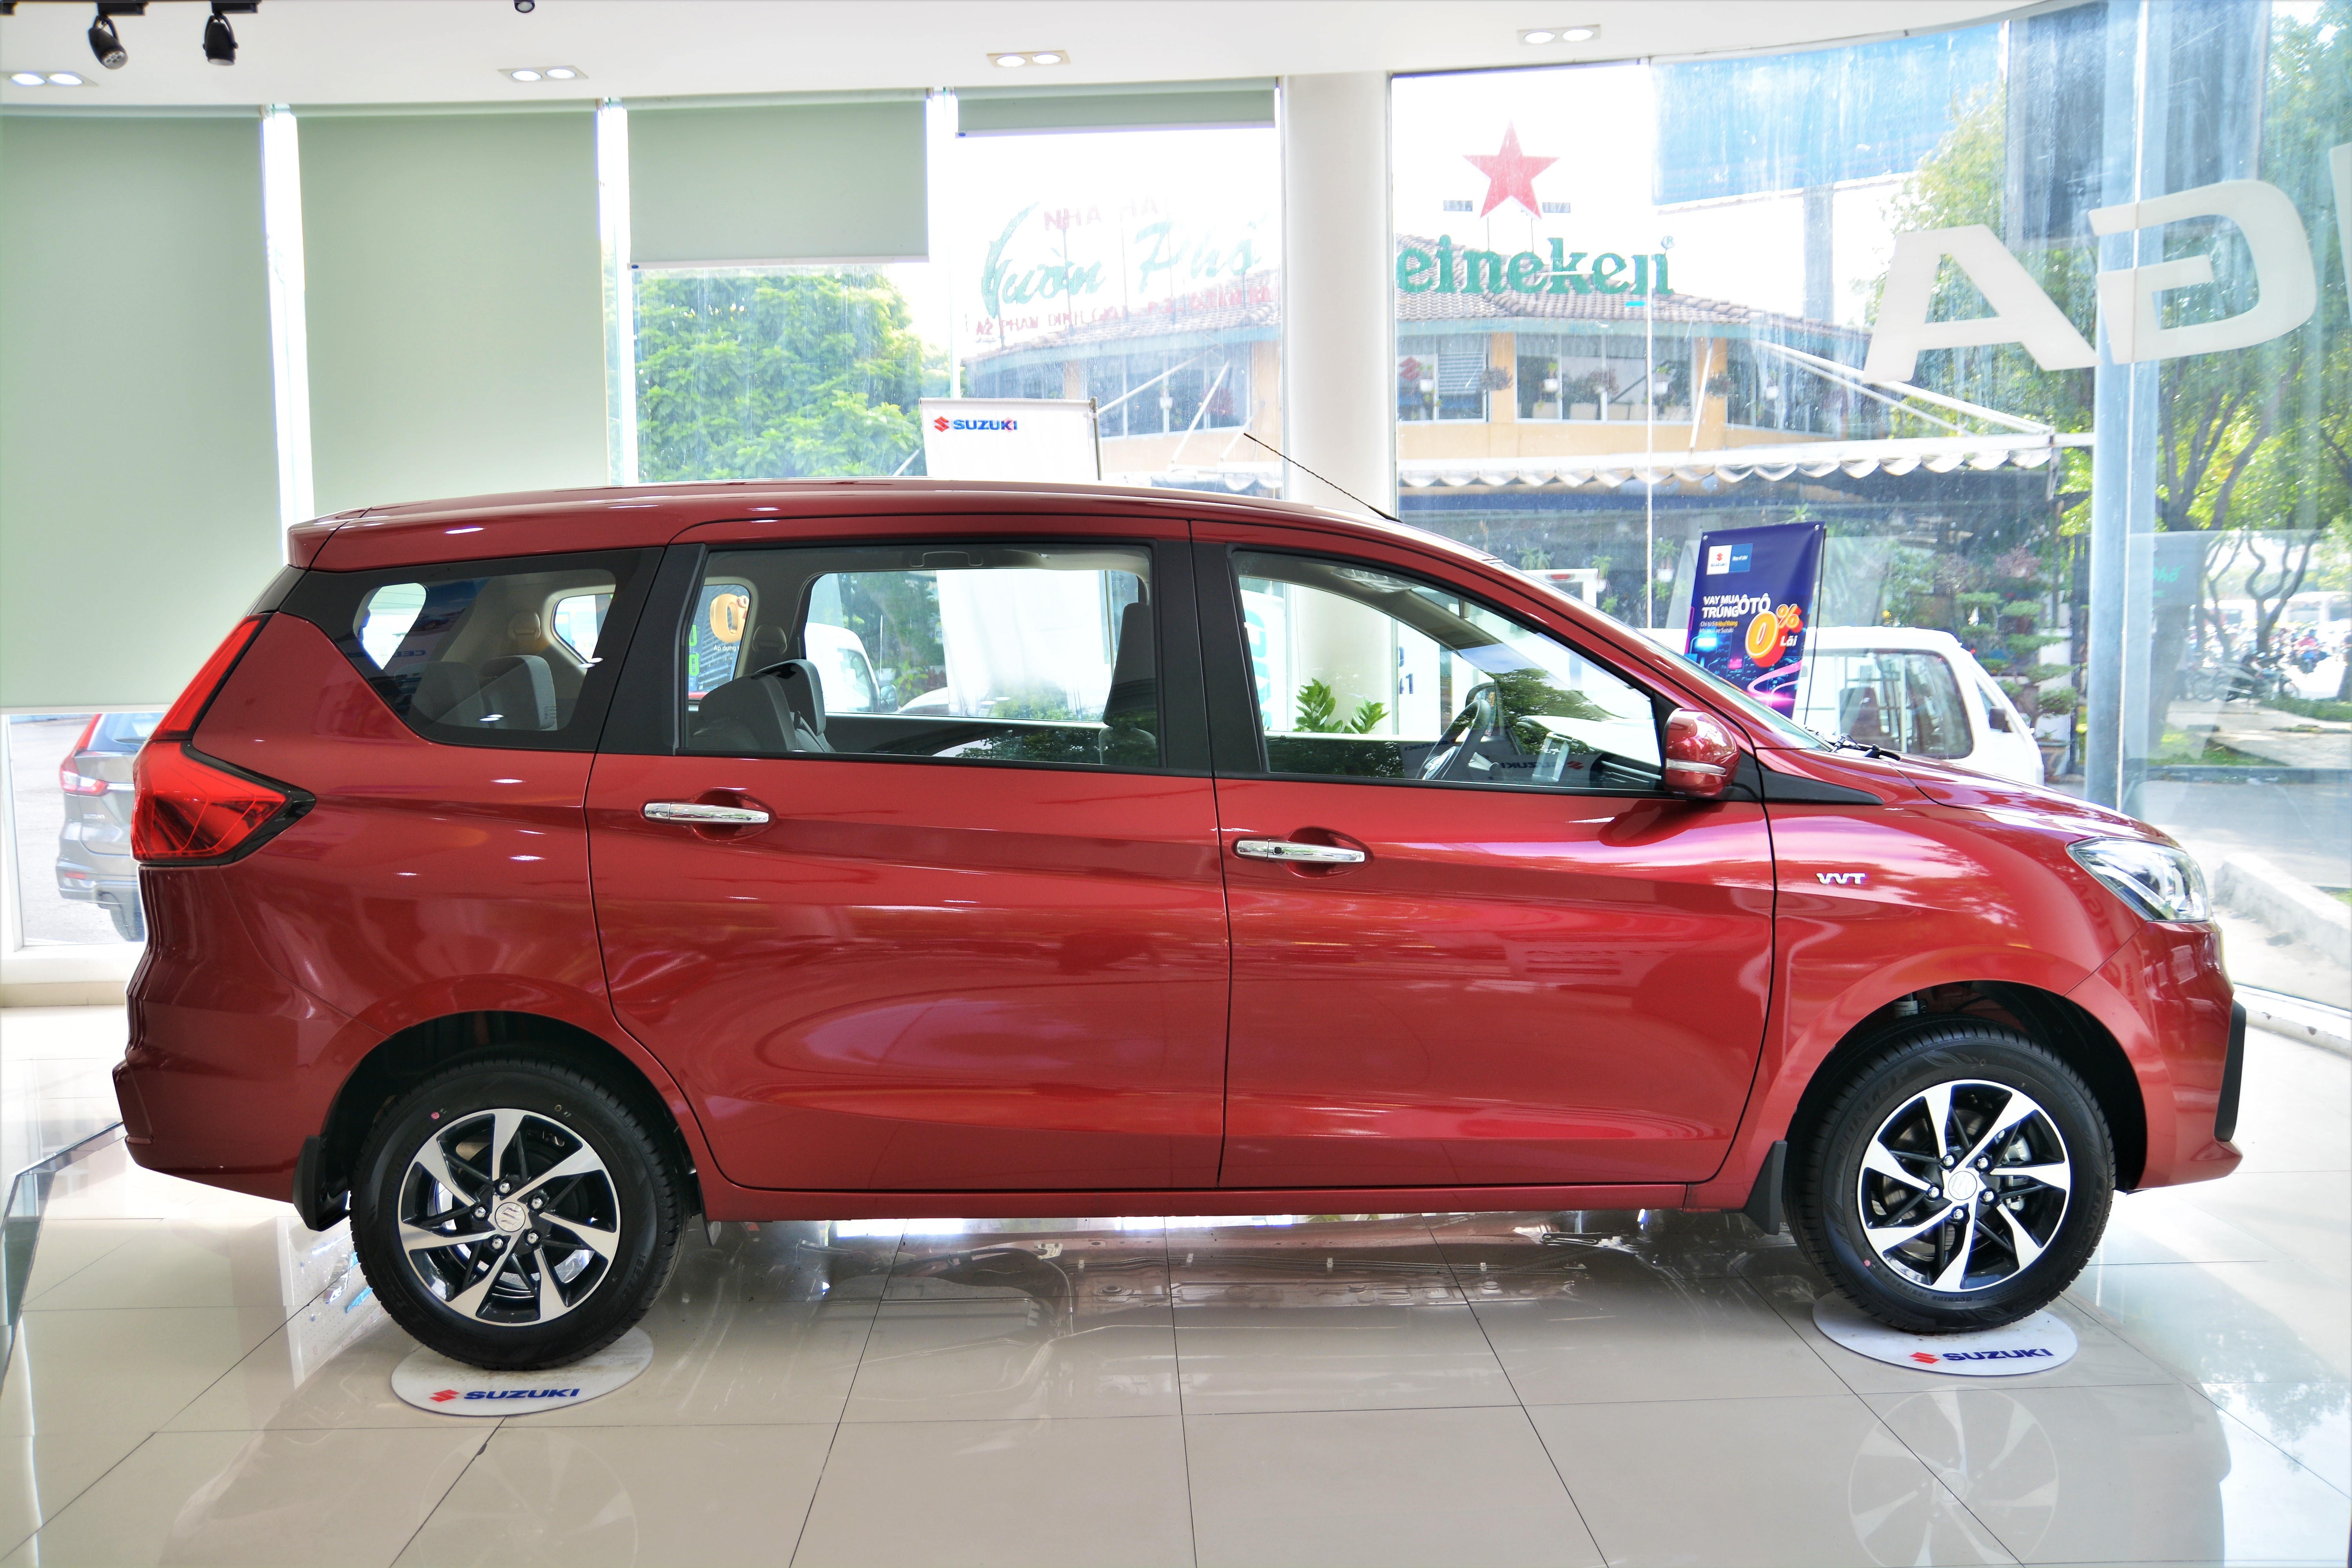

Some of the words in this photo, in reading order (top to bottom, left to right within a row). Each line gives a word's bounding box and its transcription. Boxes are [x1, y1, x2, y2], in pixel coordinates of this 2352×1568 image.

[1397, 234, 1674, 295] eineken
[953, 419, 1018, 430] SUZUKI
[1703, 595, 1721, 606] VAY
[1720, 594, 1740, 605] MUA
[1738, 593, 1771, 615] ÔTÔ
[1701, 604, 1739, 619] TRÚNG
[1780, 635, 1798, 647] Lãi
[1816, 872, 1866, 885] VVT
[1942, 1348, 2054, 1361] SUZUKI
[463, 1388, 581, 1400] SUZUKI
